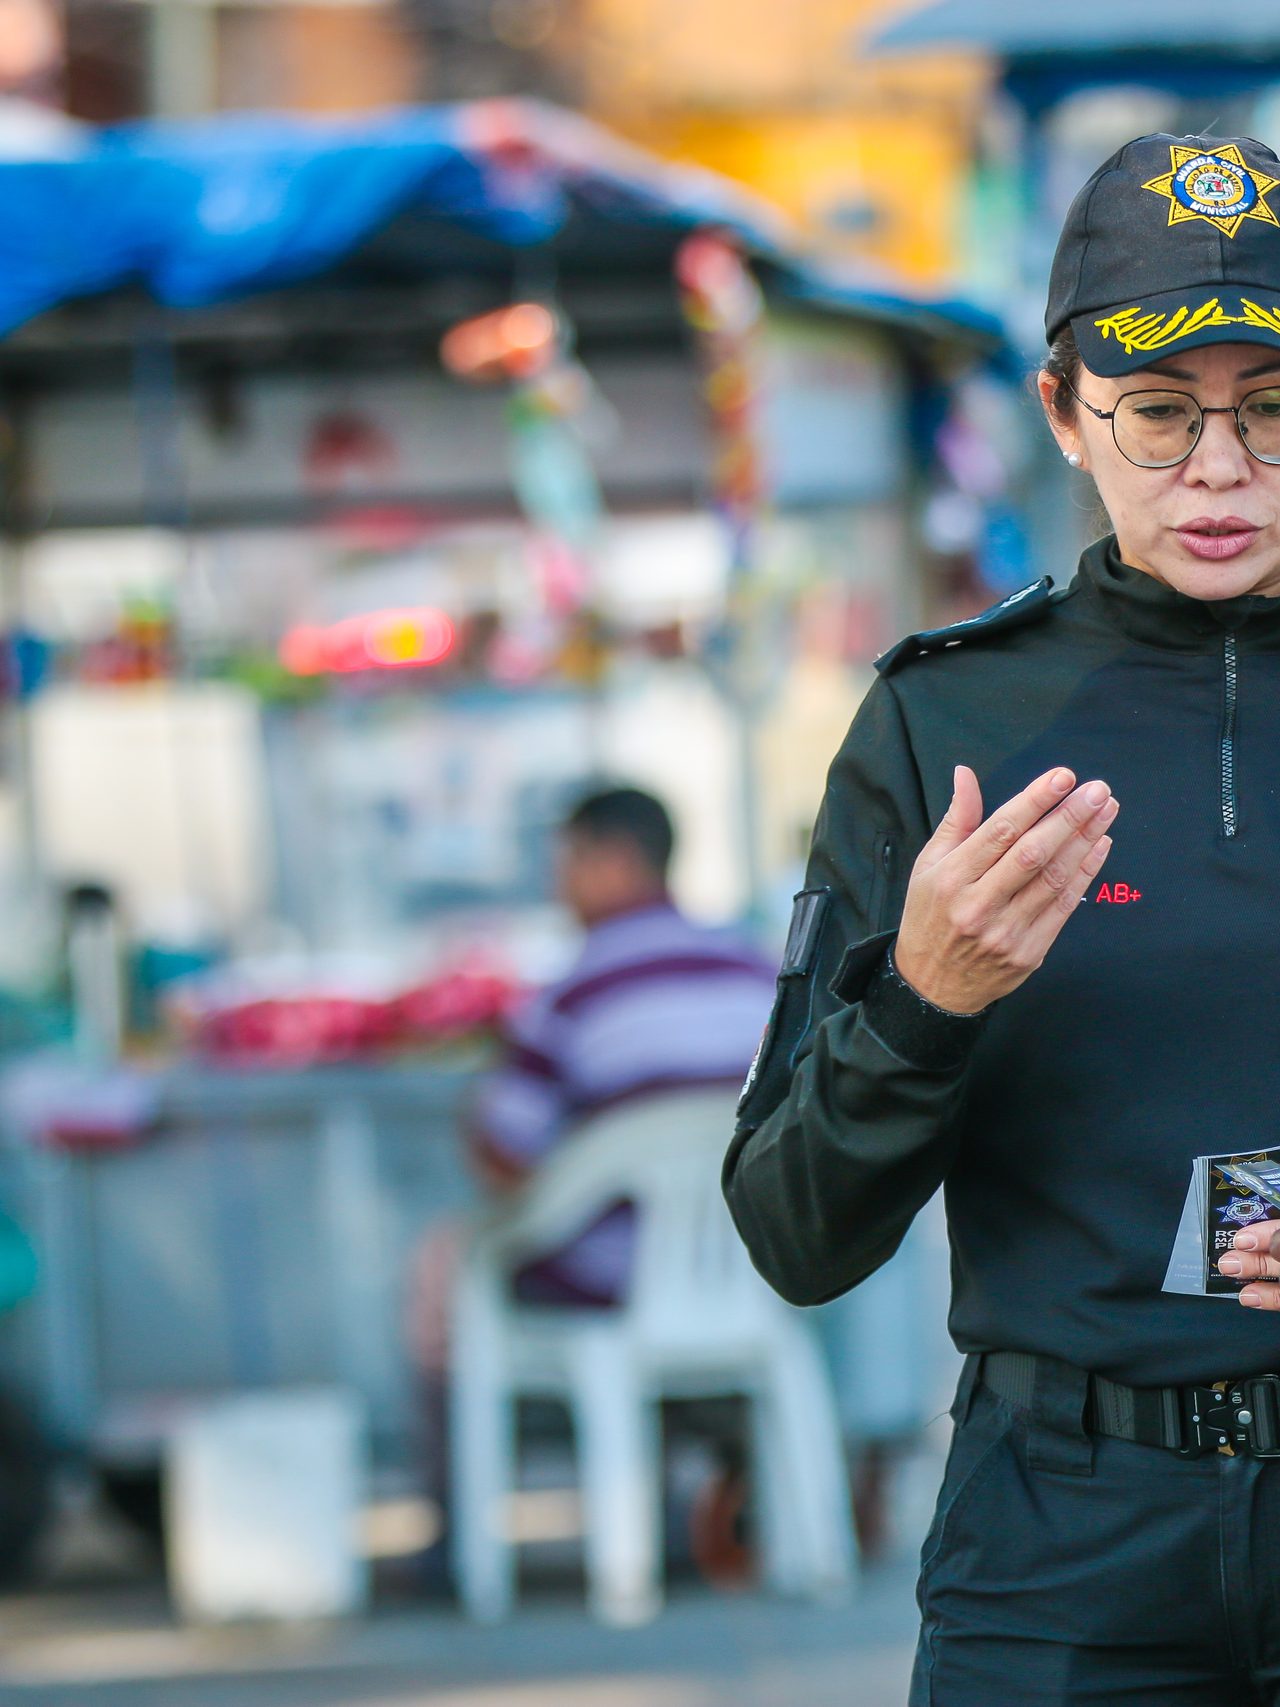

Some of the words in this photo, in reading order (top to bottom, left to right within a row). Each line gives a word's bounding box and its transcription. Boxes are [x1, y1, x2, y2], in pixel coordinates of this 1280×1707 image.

[1176, 156, 1215, 182] GUARDA
[1220, 161, 1246, 179] CIVIL
[1189, 201, 1249, 216] MUNICIPAL
[1096, 882, 1142, 904] AB+
